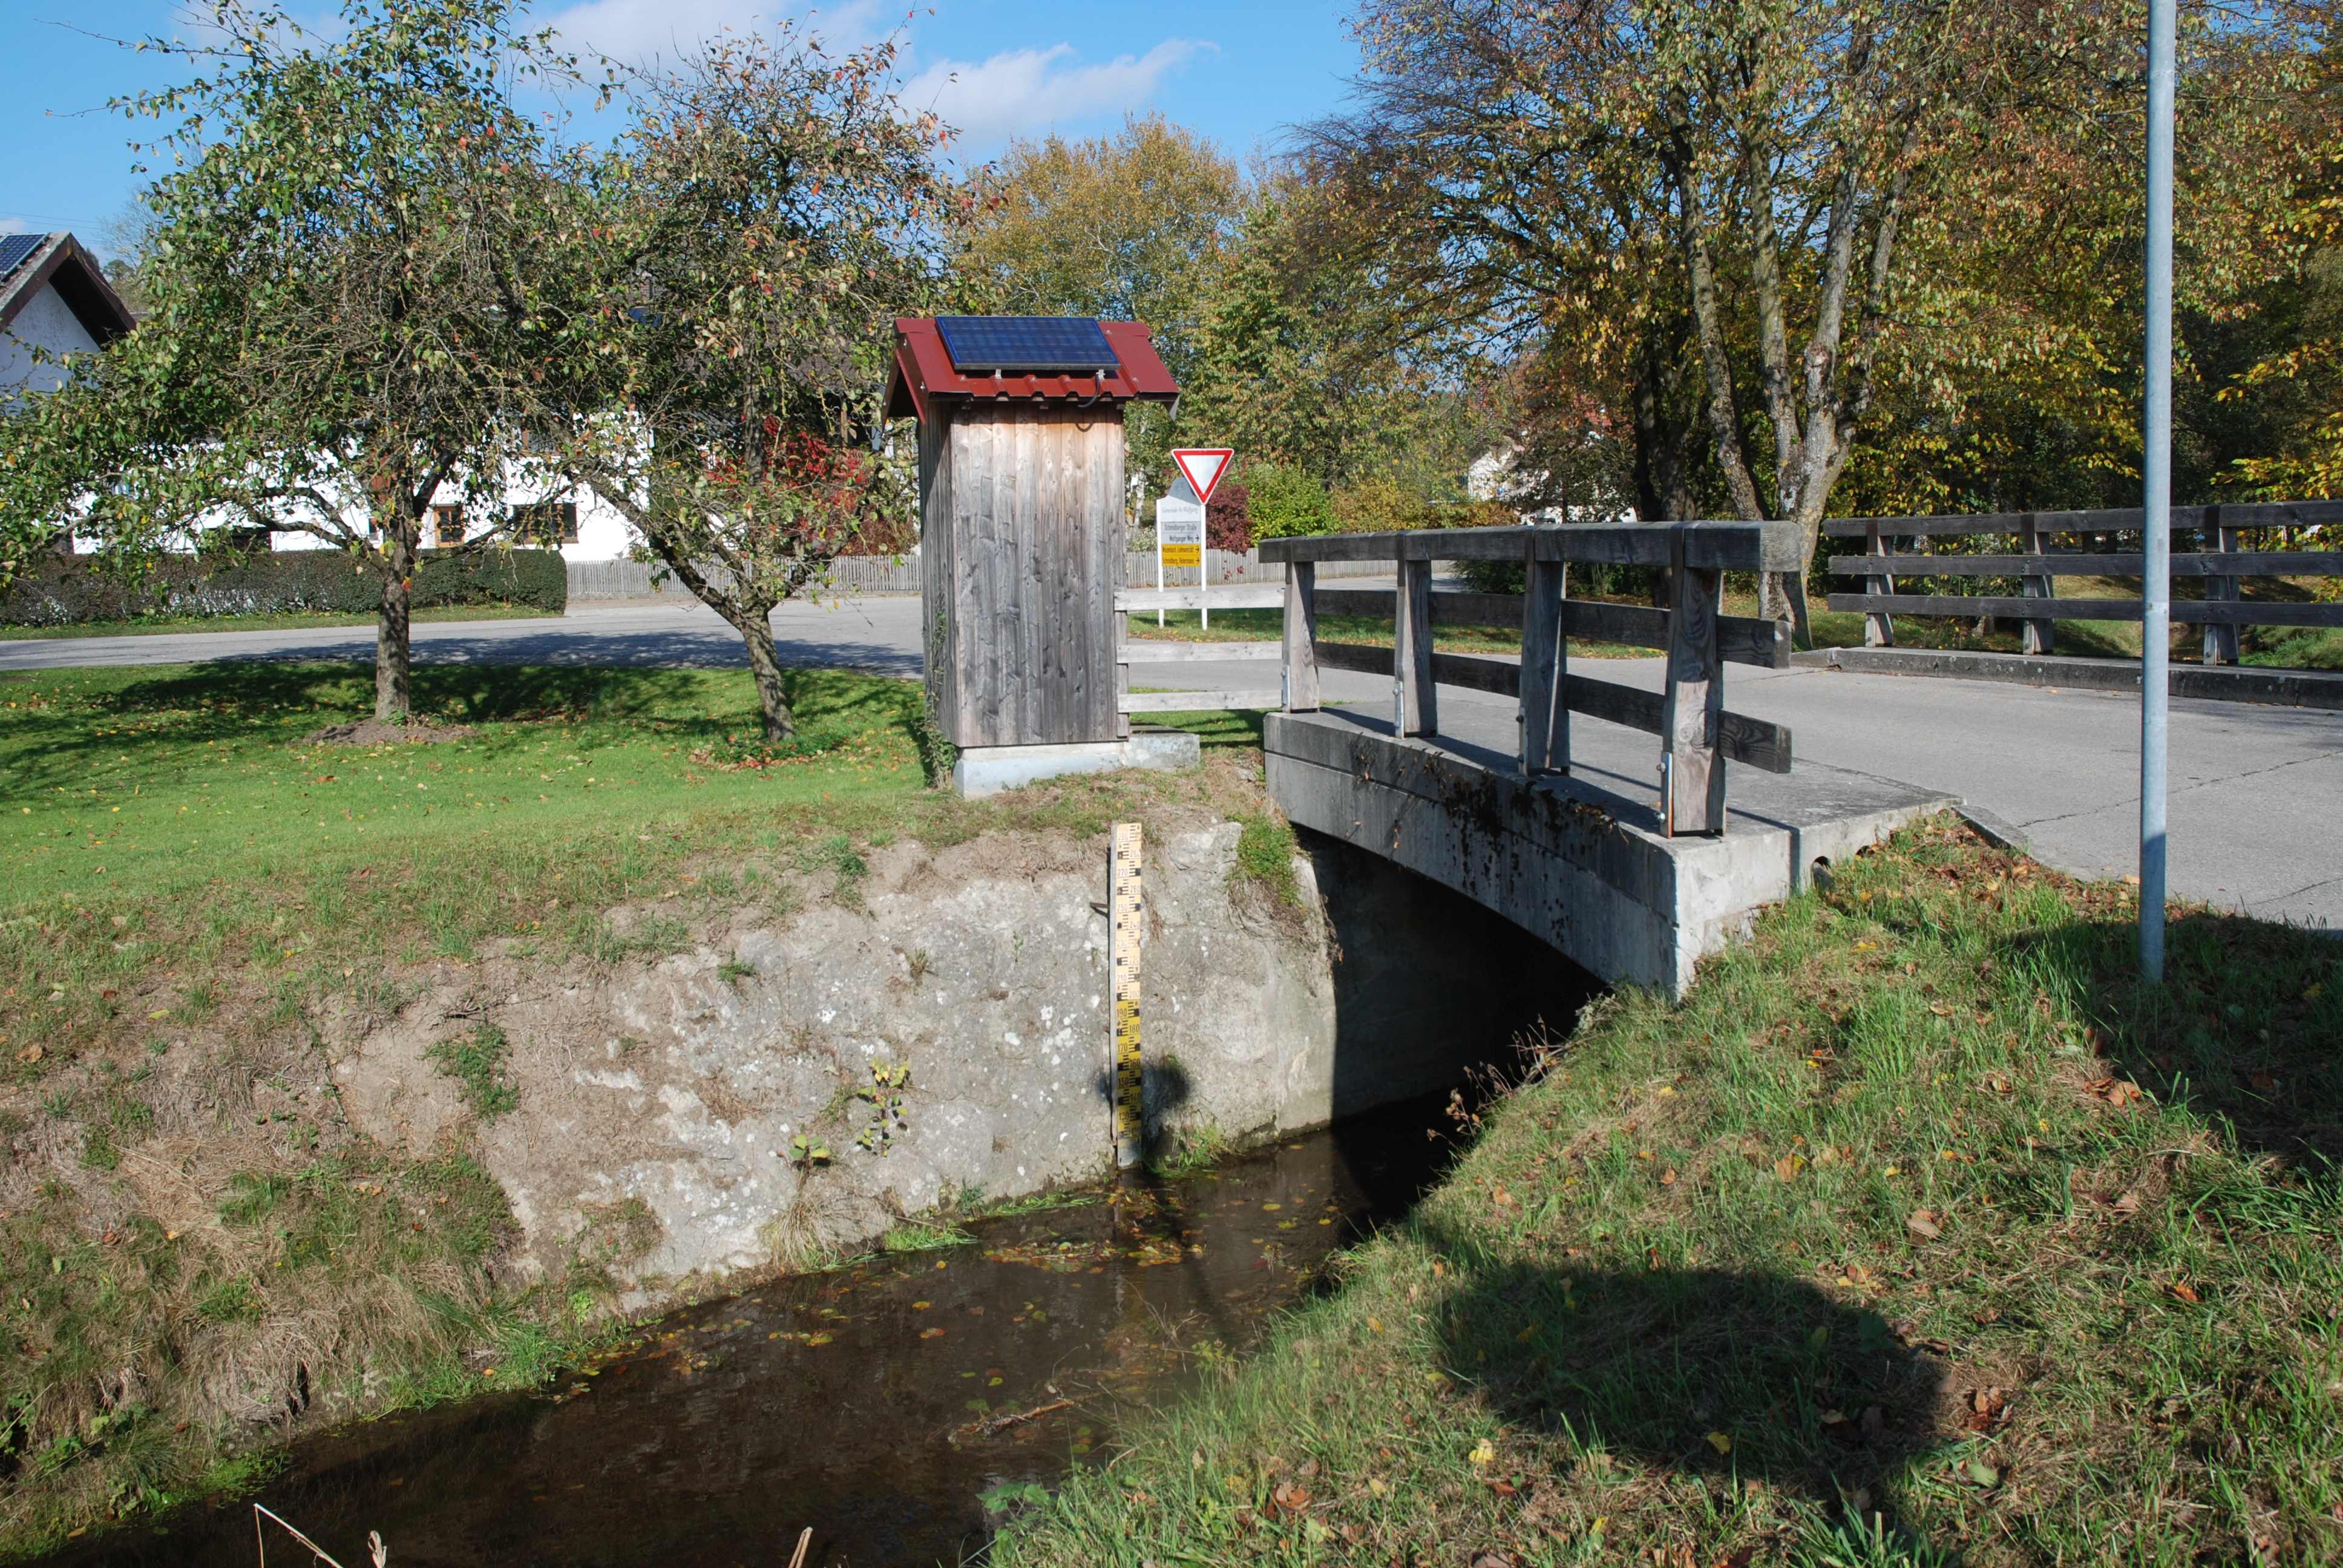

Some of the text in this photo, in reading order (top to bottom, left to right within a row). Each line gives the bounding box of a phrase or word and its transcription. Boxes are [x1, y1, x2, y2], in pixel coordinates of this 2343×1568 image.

[1118, 868, 1128, 877] 270
[1117, 975, 1127, 983] 210
[1129, 990, 1139, 999] 200
[1117, 1008, 1127, 1018] 190
[1129, 1024, 1139, 1034] 180
[1118, 1043, 1128, 1053] 170
[1118, 1077, 1129, 1087] 150
